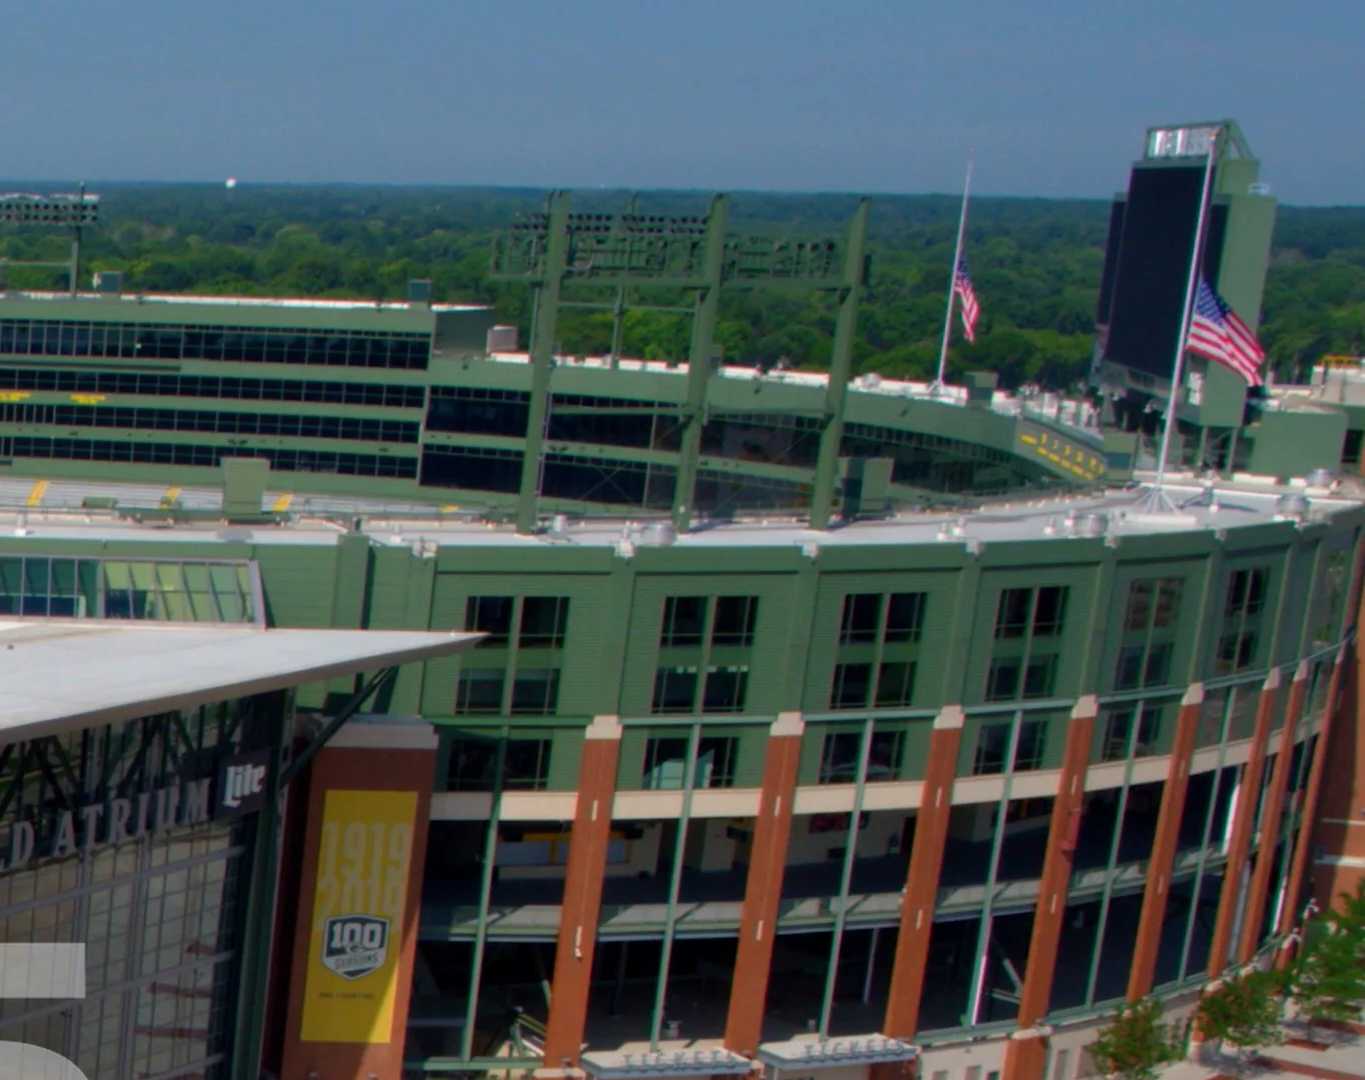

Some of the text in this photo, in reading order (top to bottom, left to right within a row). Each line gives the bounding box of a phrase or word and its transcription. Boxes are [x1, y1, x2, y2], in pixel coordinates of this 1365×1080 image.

[223, 764, 266, 808] Lite
[53, 777, 212, 858] ATRIUM
[322, 821, 413, 879] 1919
[331, 921, 383, 950] 100
[334, 951, 379, 971] SEASONS
[622, 1049, 738, 1069] TICKETS
[804, 1037, 906, 1060] TICKETS
